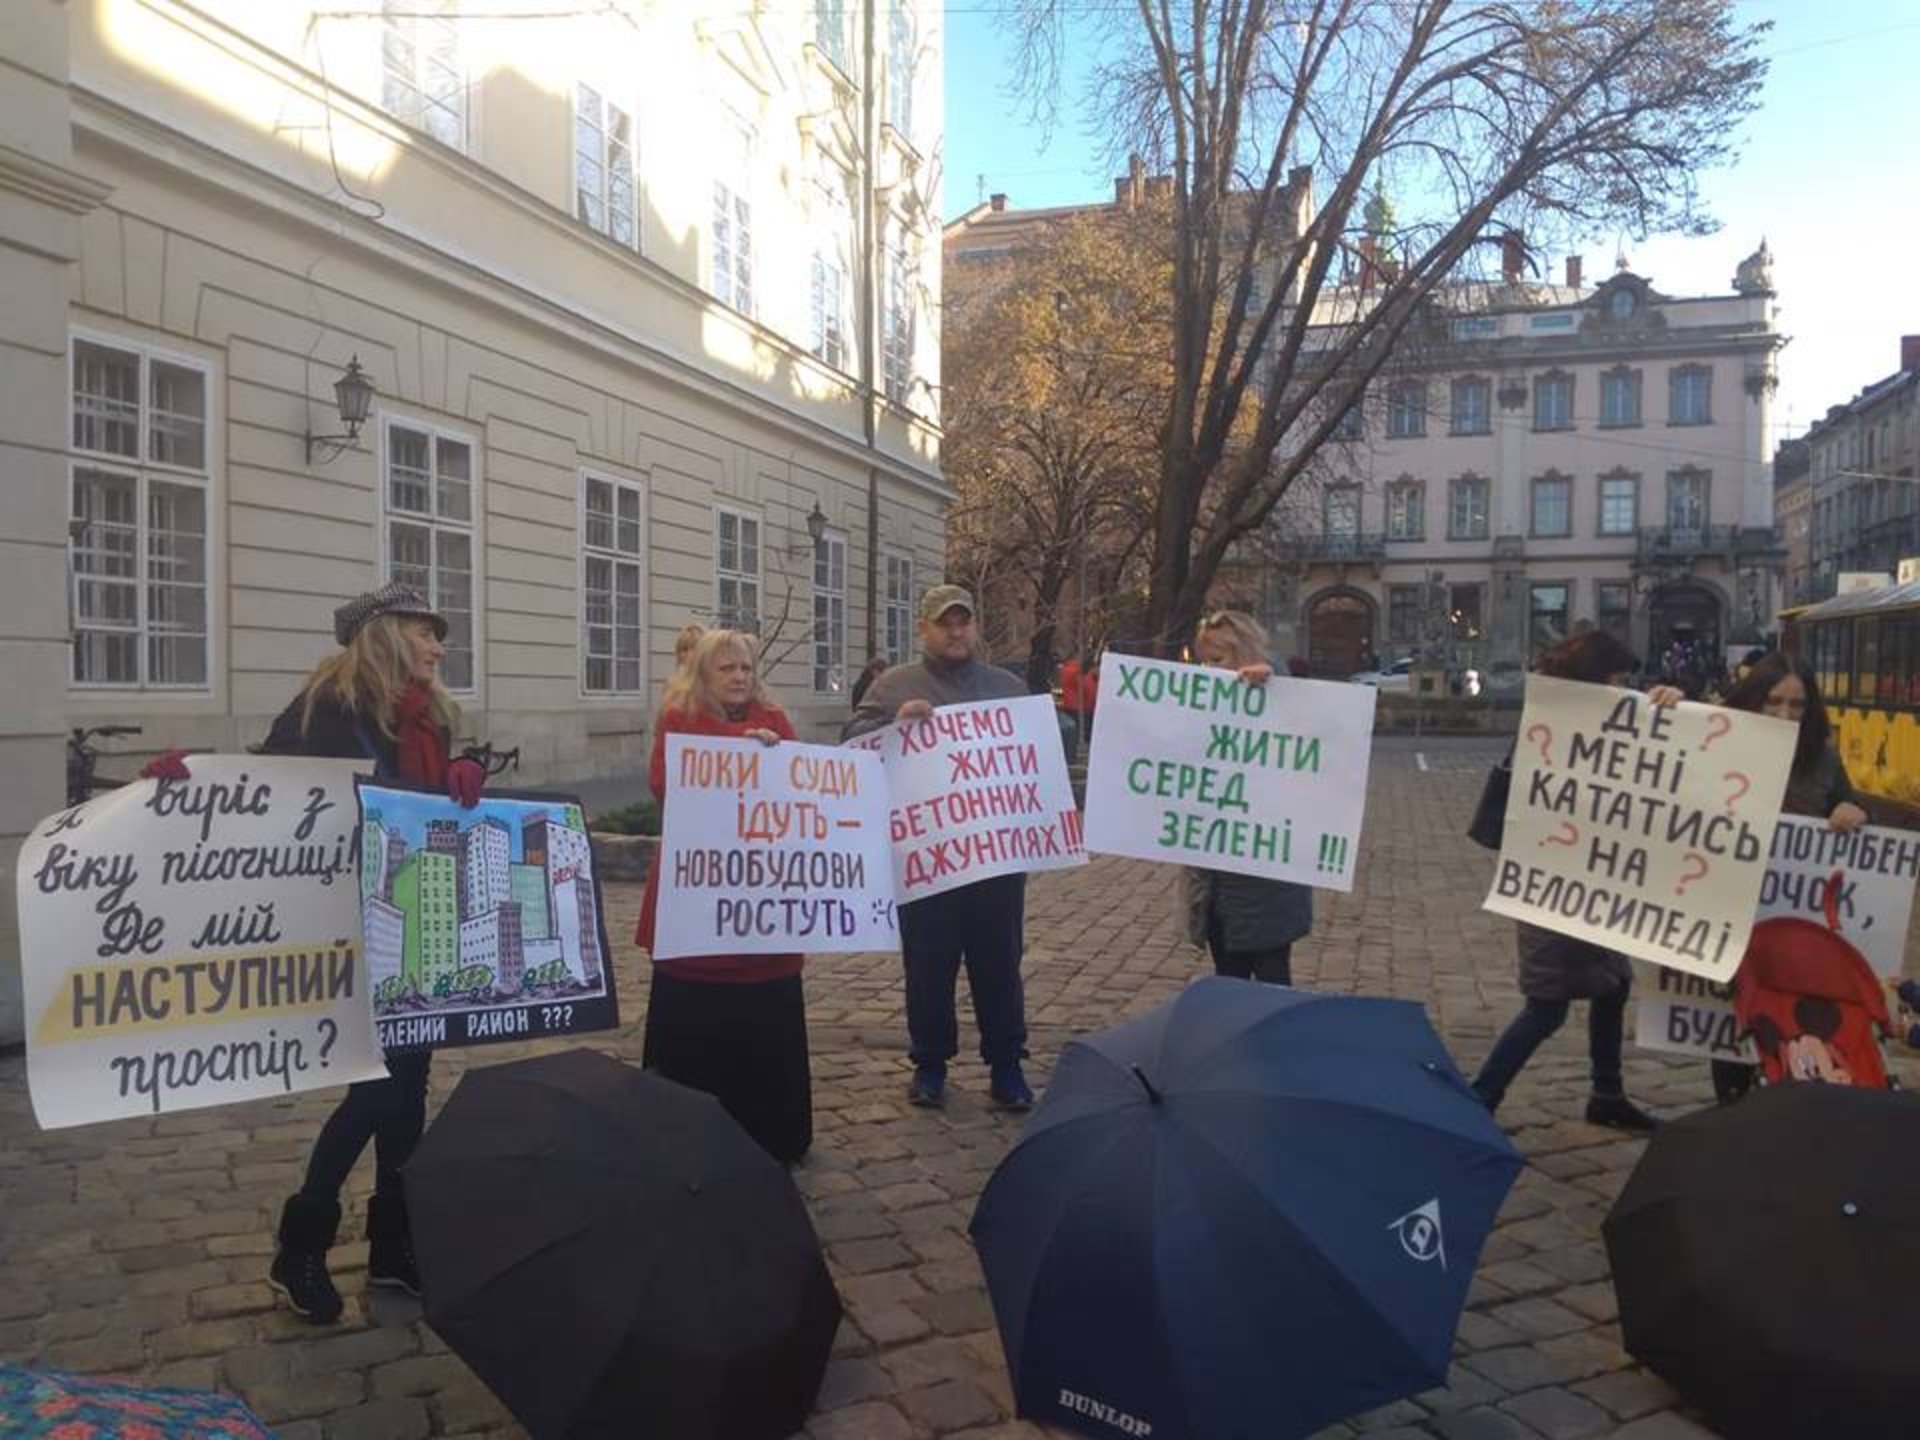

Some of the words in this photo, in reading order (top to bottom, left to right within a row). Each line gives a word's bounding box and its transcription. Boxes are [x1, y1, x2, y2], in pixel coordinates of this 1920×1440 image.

[1117, 664, 1267, 717] ХОЧЕМО
[898, 707, 1014, 757] ХОЧЕМО
[1601, 696, 1678, 741] ДЕ
[681, 749, 760, 789] ПОКИ
[789, 755, 857, 799] СУДИ
[948, 744, 1038, 784] ЖИТИ
[1206, 725, 1320, 773] ЖИТИ
[1128, 758, 1249, 813] СЕРЕД
[890, 782, 1043, 842] БЕТОННИХ
[1529, 770, 1760, 861] КАТАТИСЬ
[34, 843, 138, 913] віку
[675, 850, 865, 892] НОВОБУДОВИ
[1587, 836, 1648, 887] НА
[97, 901, 164, 957] Де
[191, 902, 281, 949] мій
[716, 899, 856, 937] РОСТУТЬ
[72, 940, 355, 1029] НАСТУПНИЙ
[379, 1017, 447, 1048] ЕЛЕНИЙ
[467, 1007, 529, 1037] РАЙОН
[541, 1005, 573, 1029] ???
[1668, 1004, 1741, 1056] БУД
[1059, 1388, 1152, 1438] DUNLOP
